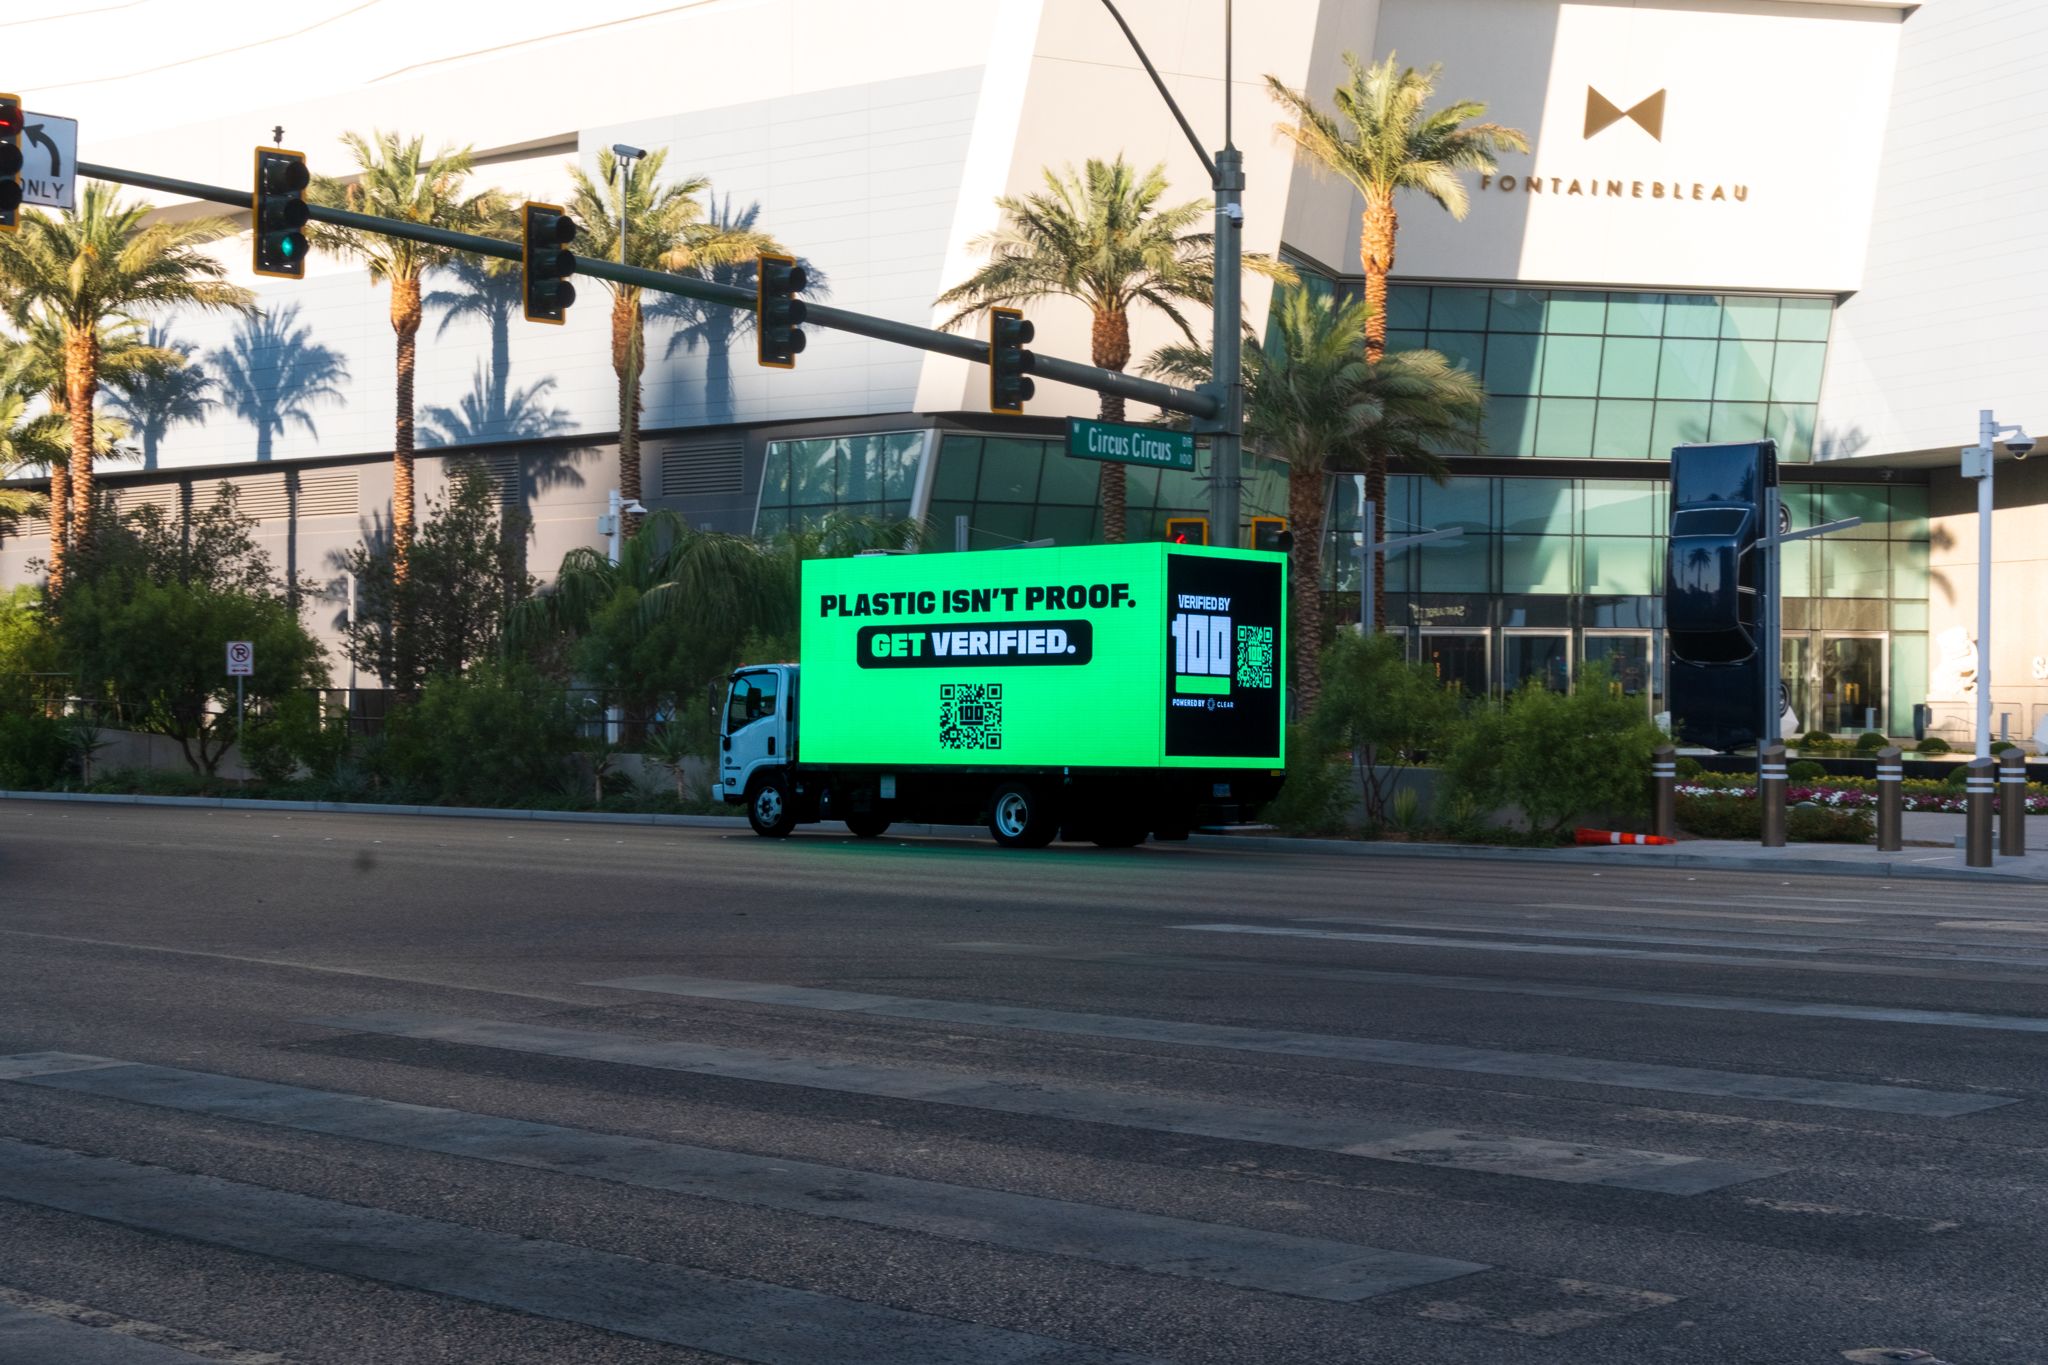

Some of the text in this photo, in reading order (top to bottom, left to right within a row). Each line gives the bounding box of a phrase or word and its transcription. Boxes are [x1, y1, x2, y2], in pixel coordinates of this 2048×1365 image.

[1481, 174, 1749, 202] FONTAINEBLEAU
[1088, 427, 1172, 461] Circus Circus
[1182, 436, 1193, 448] DR
[1180, 454, 1193, 465] 100
[820, 583, 1136, 618] PLASTIC ISN'T PROOF.
[1178, 594, 1231, 611] VERIFIED BY
[871, 629, 1076, 658] GET VERIFIED.
[1172, 613, 1231, 675] 100
[1172, 698, 1205, 708] POWERED BY
